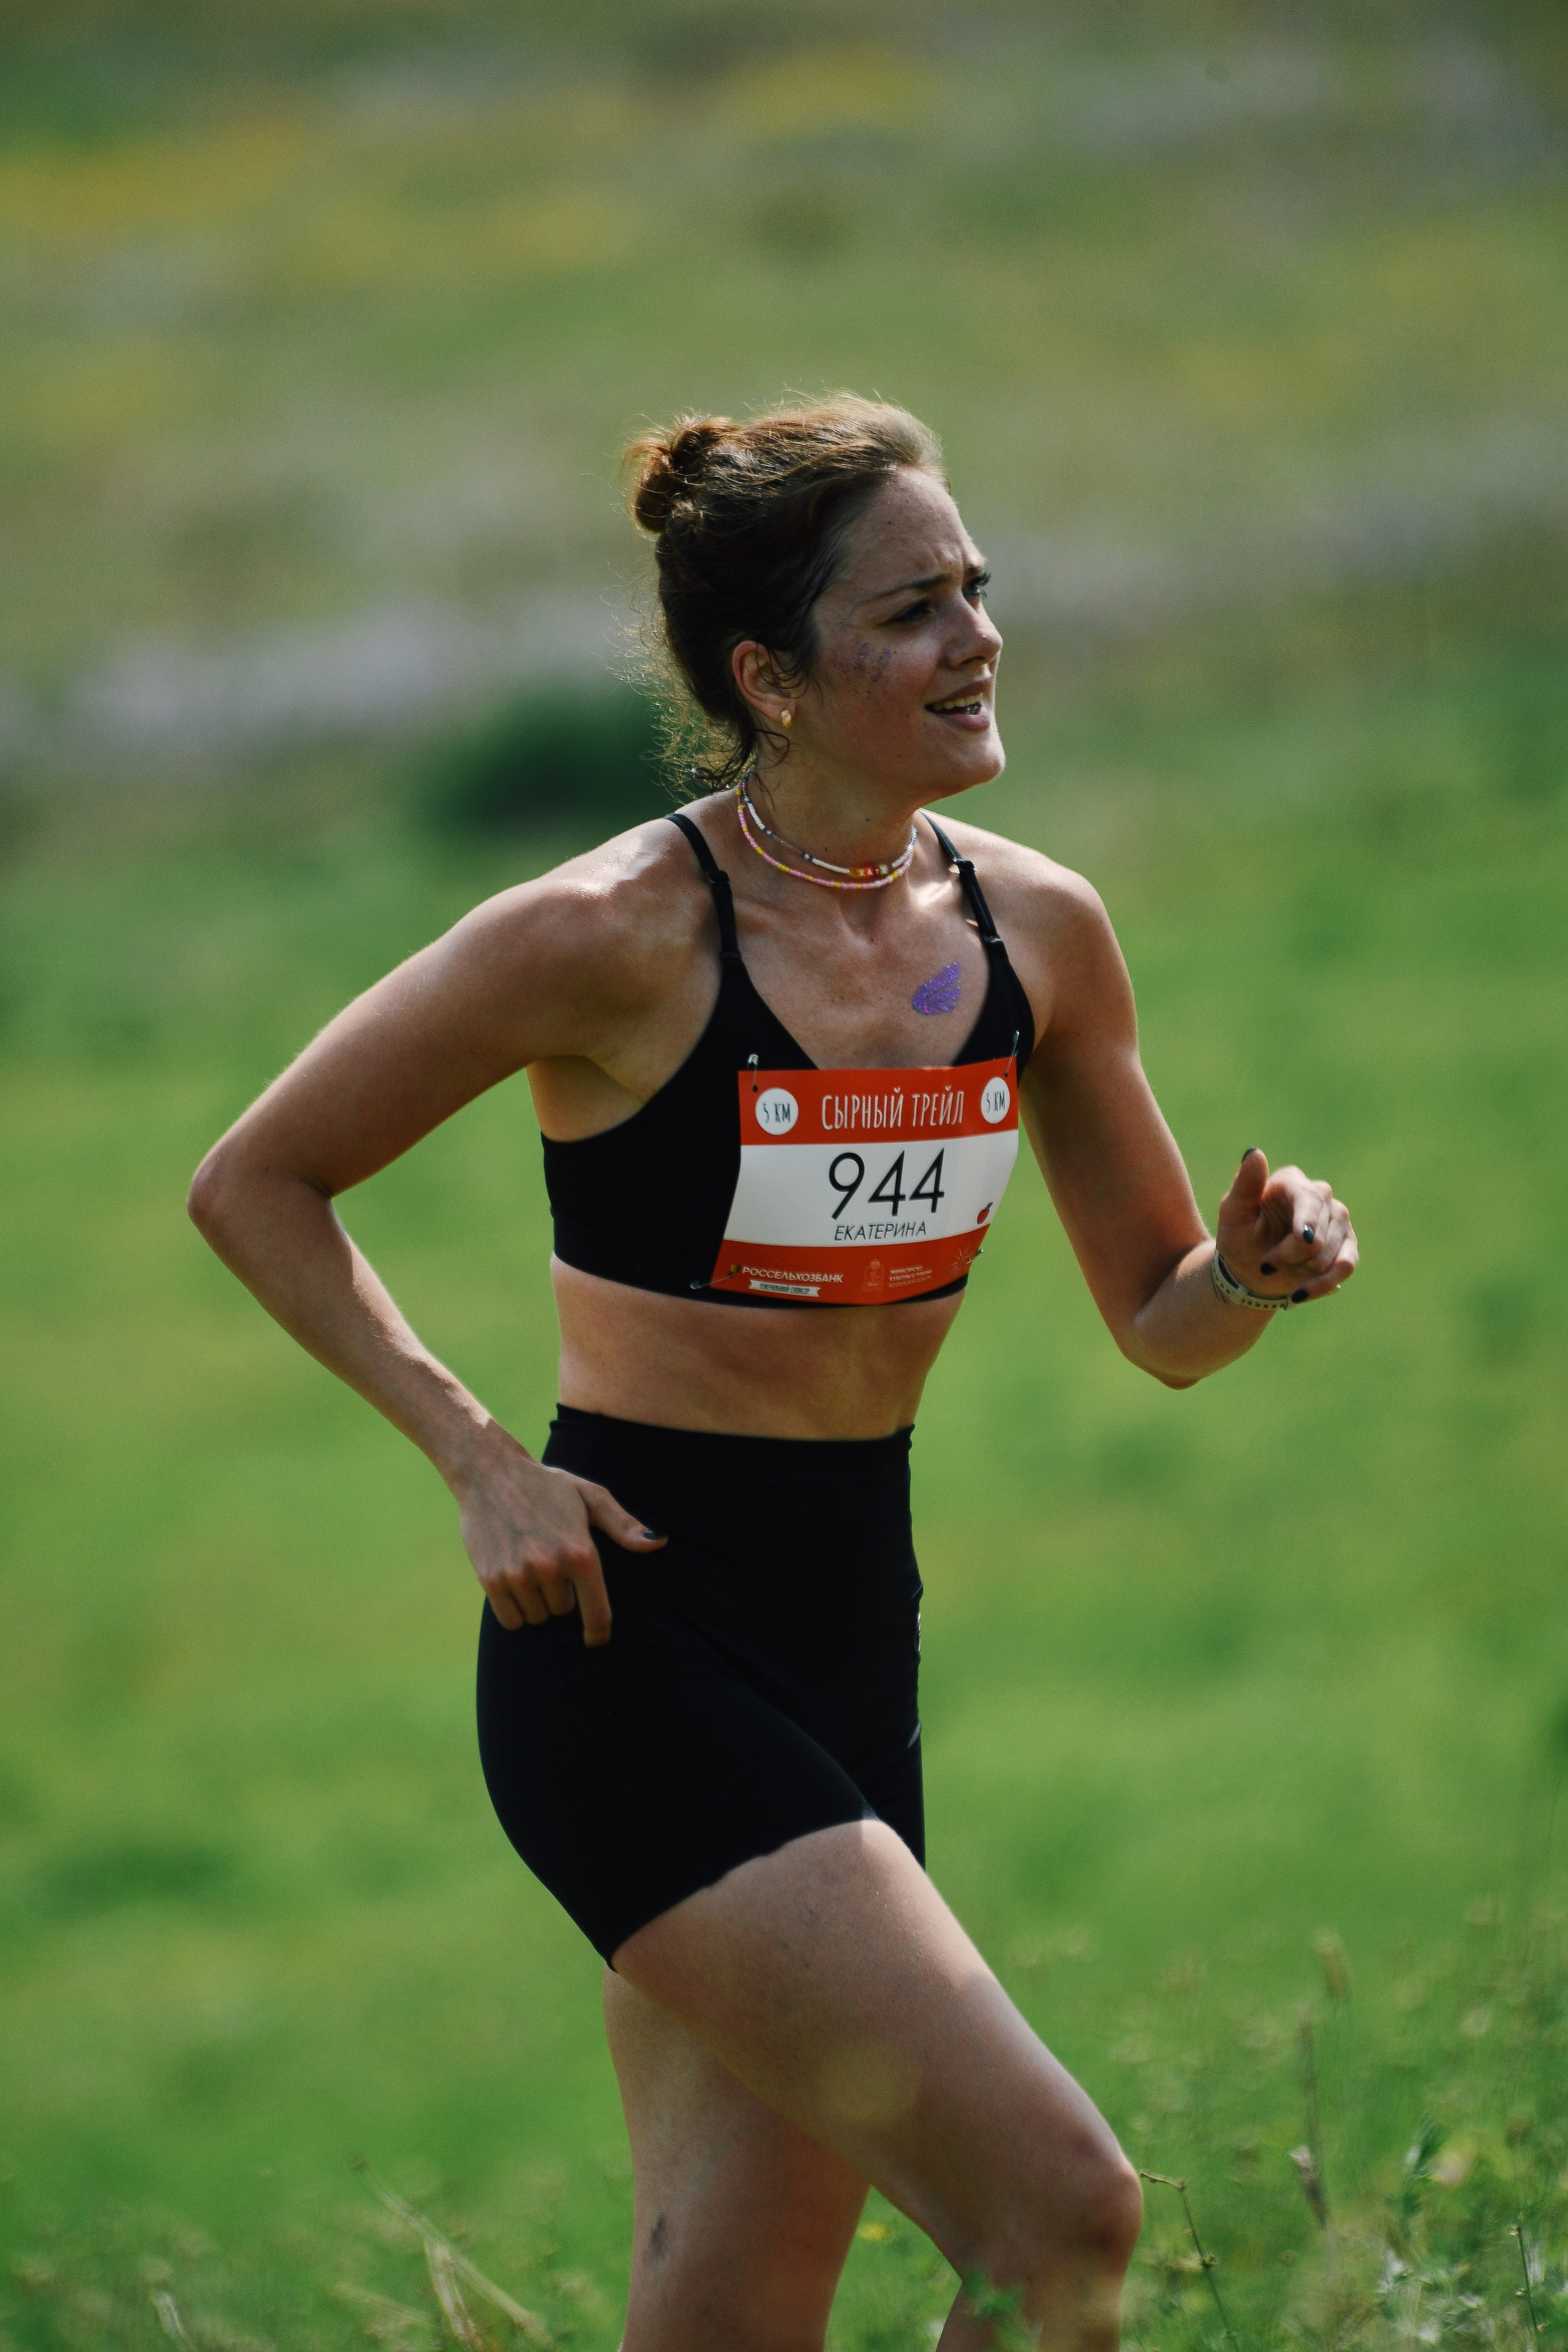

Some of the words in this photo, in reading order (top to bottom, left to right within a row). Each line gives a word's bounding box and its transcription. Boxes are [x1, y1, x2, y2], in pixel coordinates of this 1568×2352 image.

[763, 1102, 770, 1123] 5
[821, 1086, 904, 1130] СЫРНЫЙ
[912, 1085, 965, 1128] ТРЕЙЛ
[986, 1093, 991, 1113] 5
[828, 1147, 945, 1221] 944
[834, 1221, 927, 1241] ЕКАТЕРИНА
[742, 1266, 844, 1283] РОССЕЛЬХОЗБАНК
